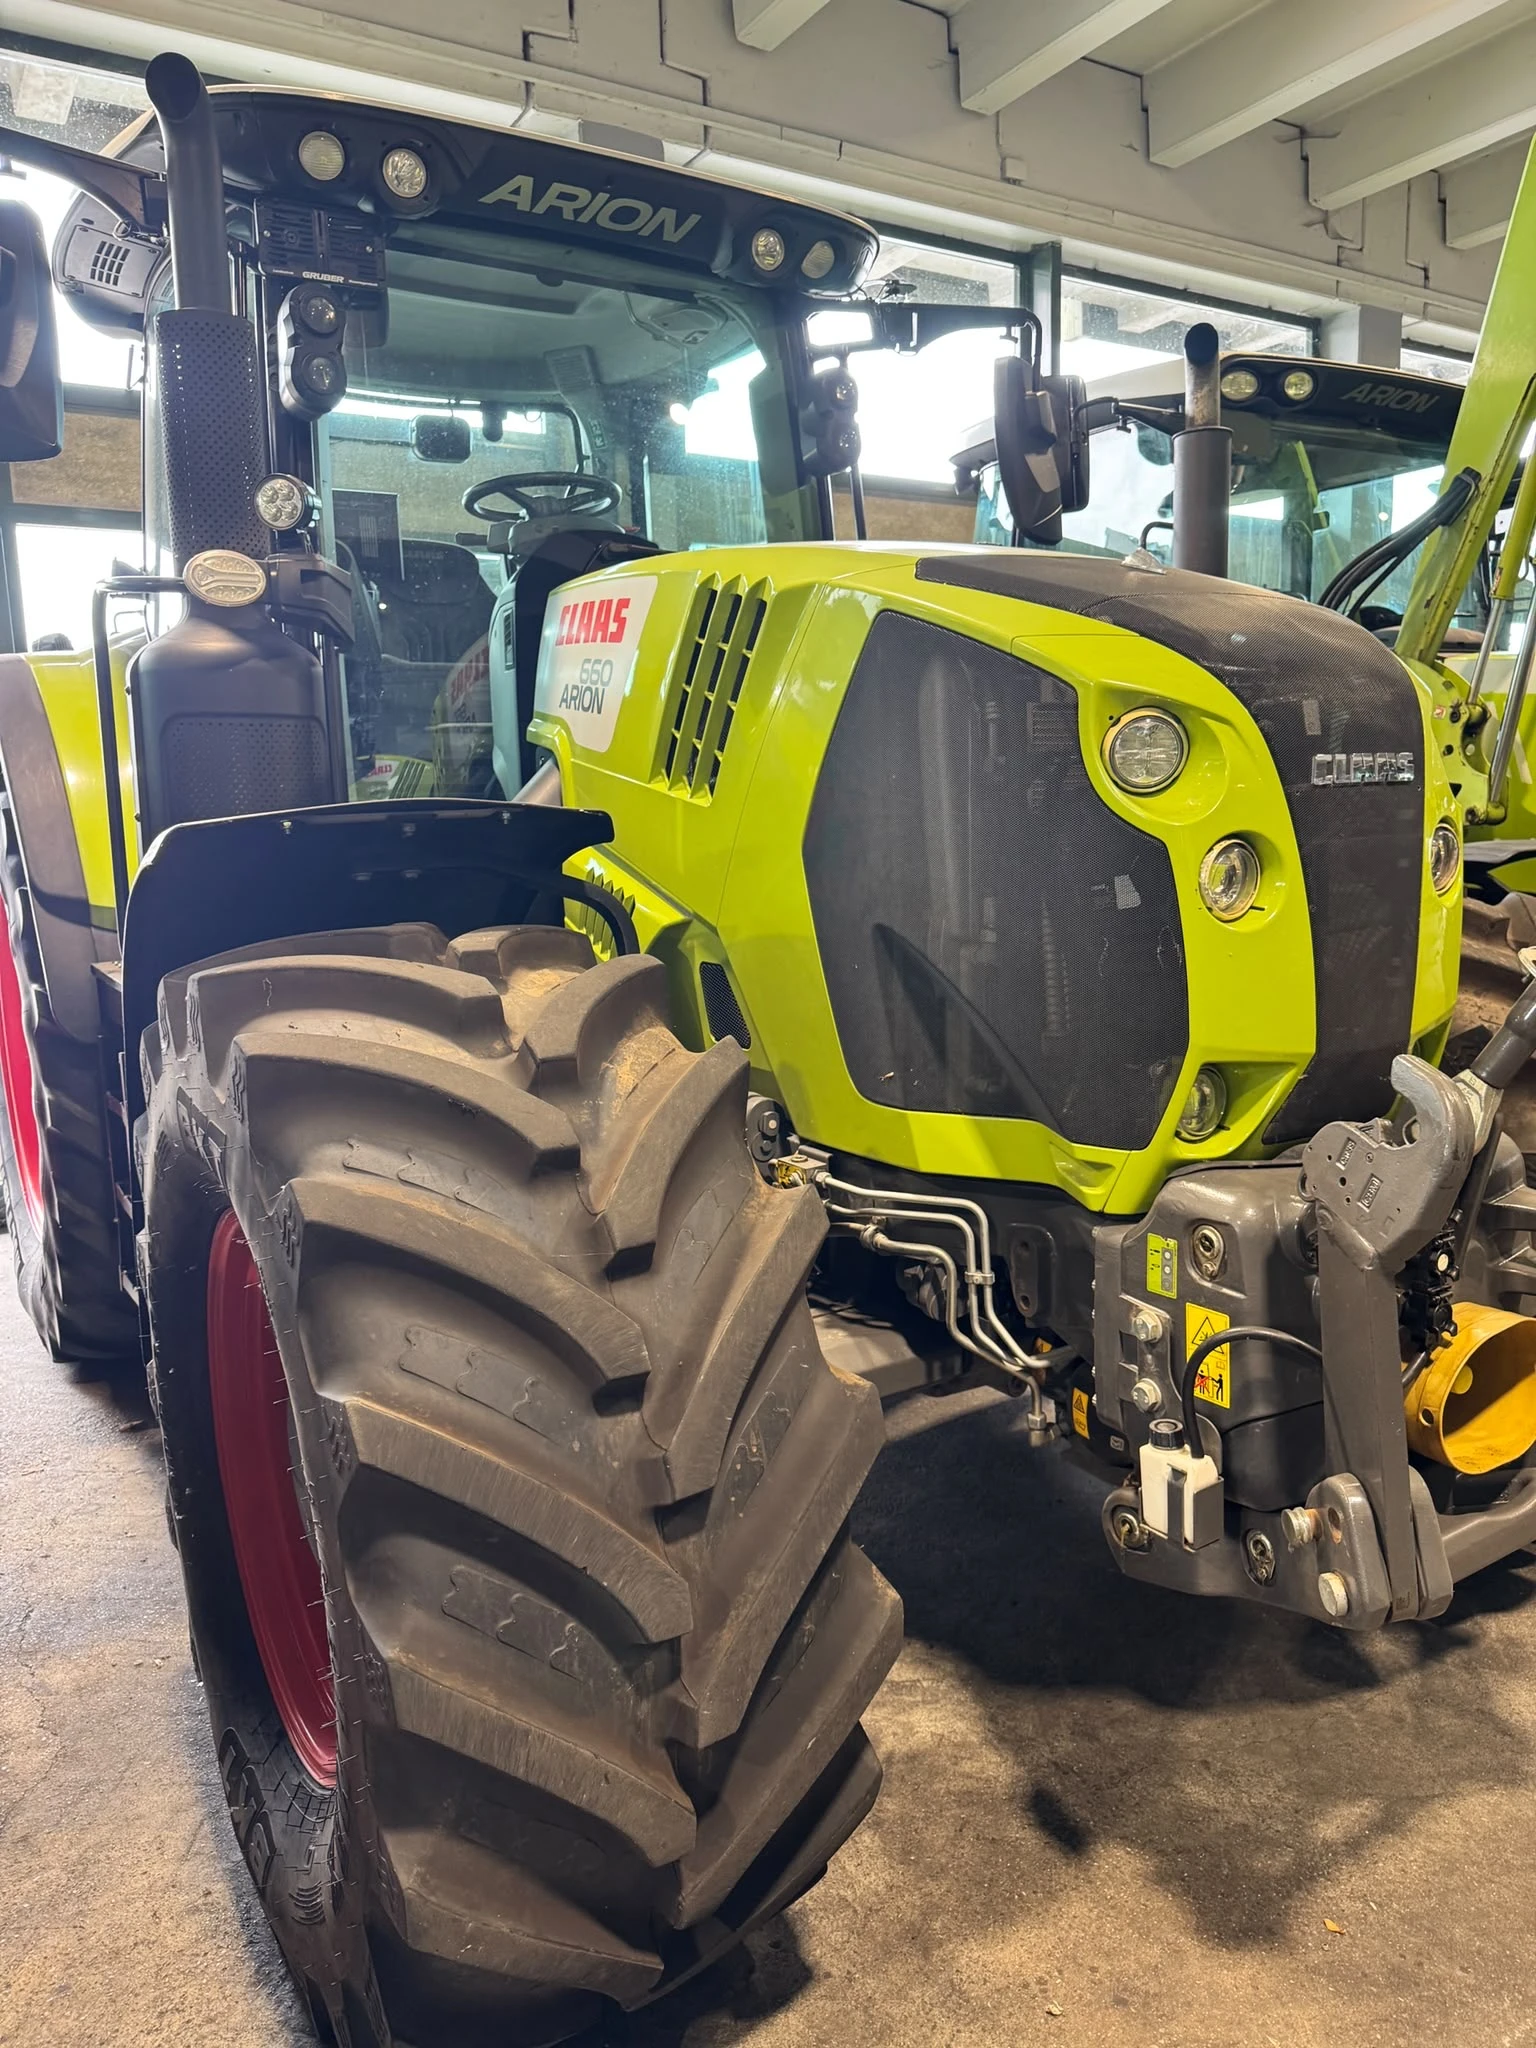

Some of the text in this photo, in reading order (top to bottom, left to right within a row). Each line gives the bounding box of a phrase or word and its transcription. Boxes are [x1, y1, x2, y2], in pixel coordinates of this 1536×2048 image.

[478, 174, 702, 243] ARION
[302, 271, 345, 283] GRUBER
[1340, 382, 1441, 413] ARION
[555, 598, 631, 647] CLAAS
[579, 658, 614, 687] 660
[558, 683, 606, 715] ARION
[1311, 752, 1415, 785] CLAAS
